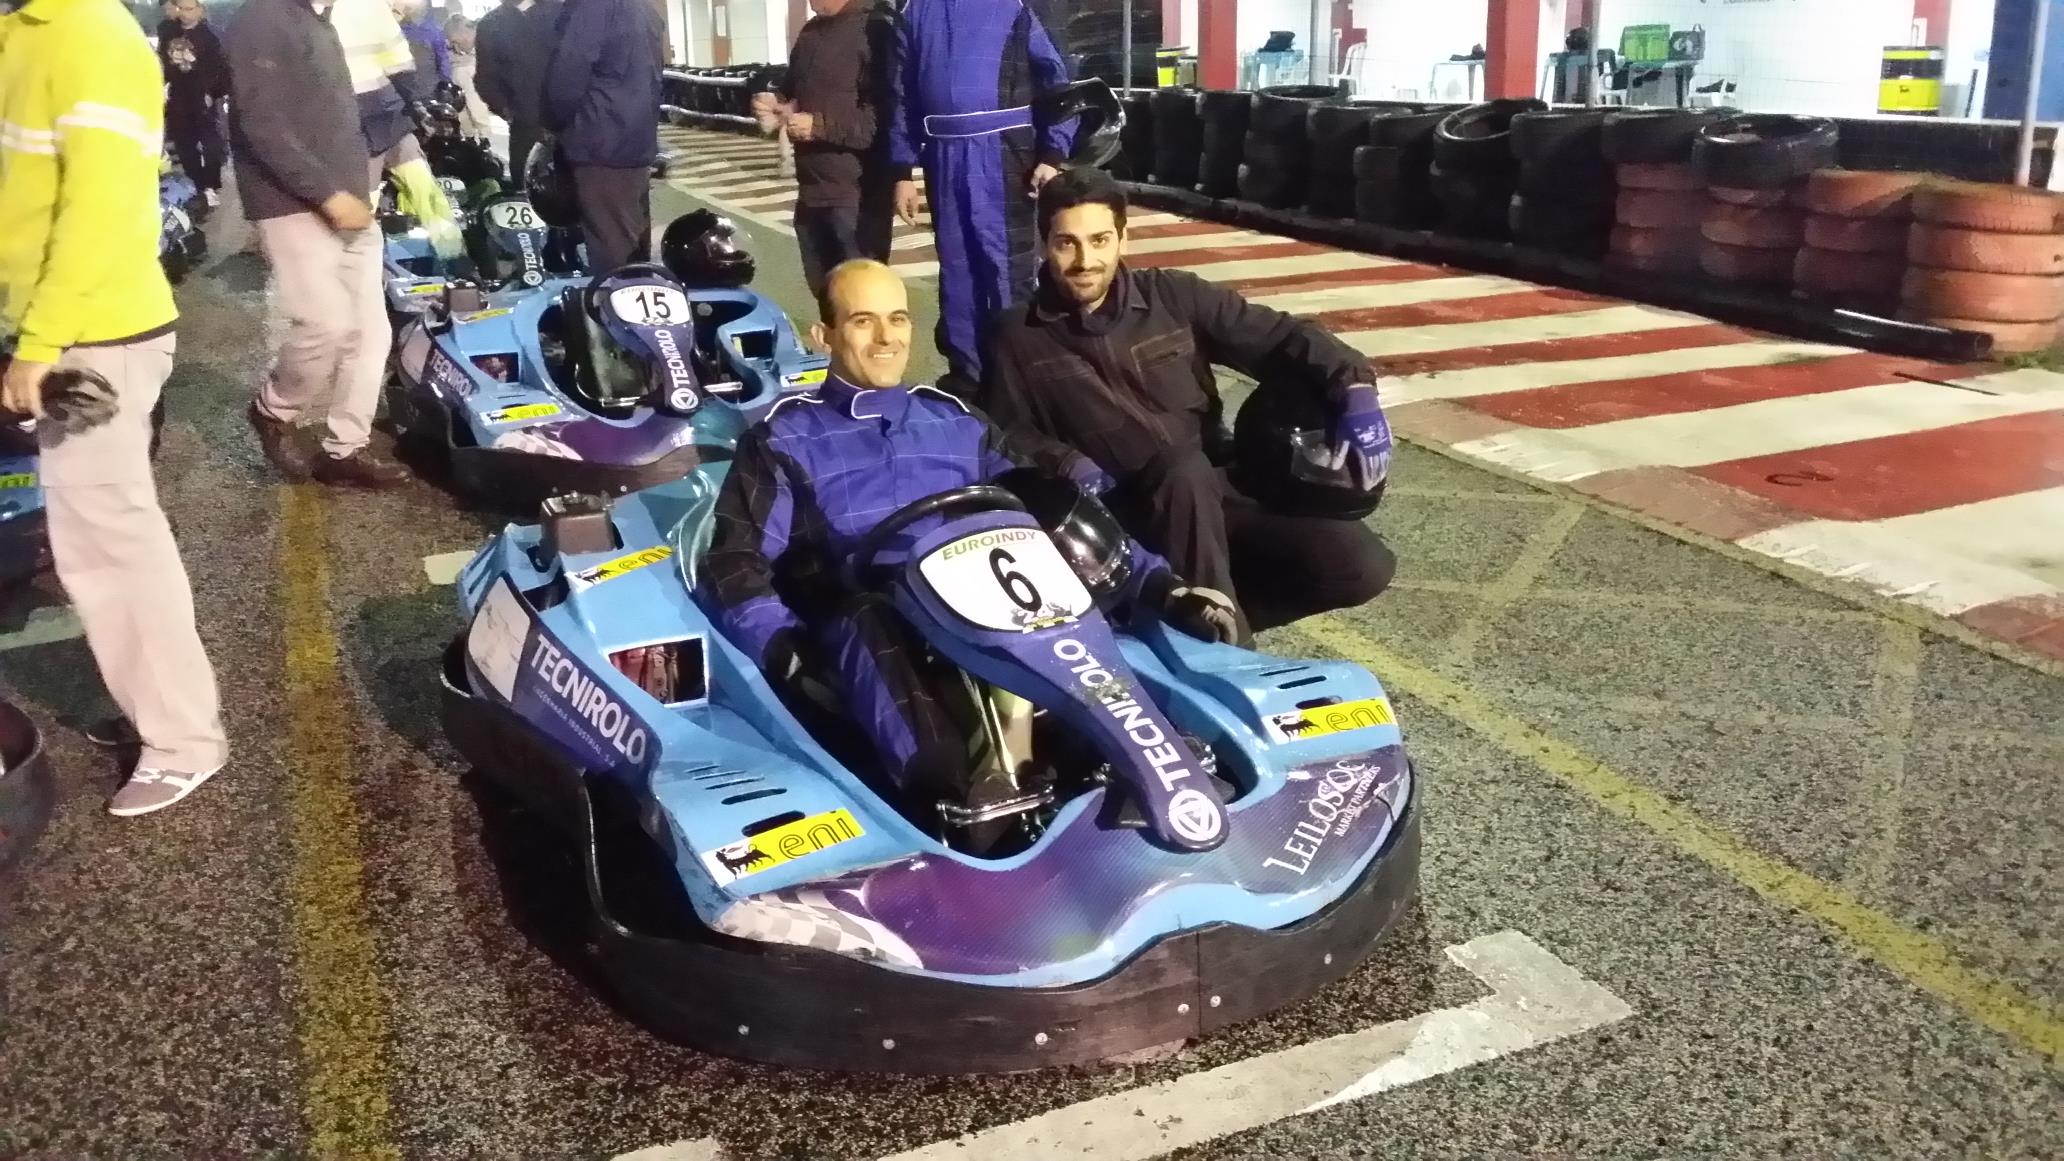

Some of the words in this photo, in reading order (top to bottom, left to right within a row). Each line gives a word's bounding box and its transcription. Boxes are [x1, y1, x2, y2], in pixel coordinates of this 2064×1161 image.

[505, 206, 533, 226] 26
[635, 291, 671, 319] 15
[618, 547, 673, 571] eni
[942, 531, 1037, 561] EUROINDY
[989, 547, 1042, 612] 6
[530, 633, 647, 765] TECNIROLO
[1326, 698, 1392, 732] eni
[778, 810, 856, 860] eni
